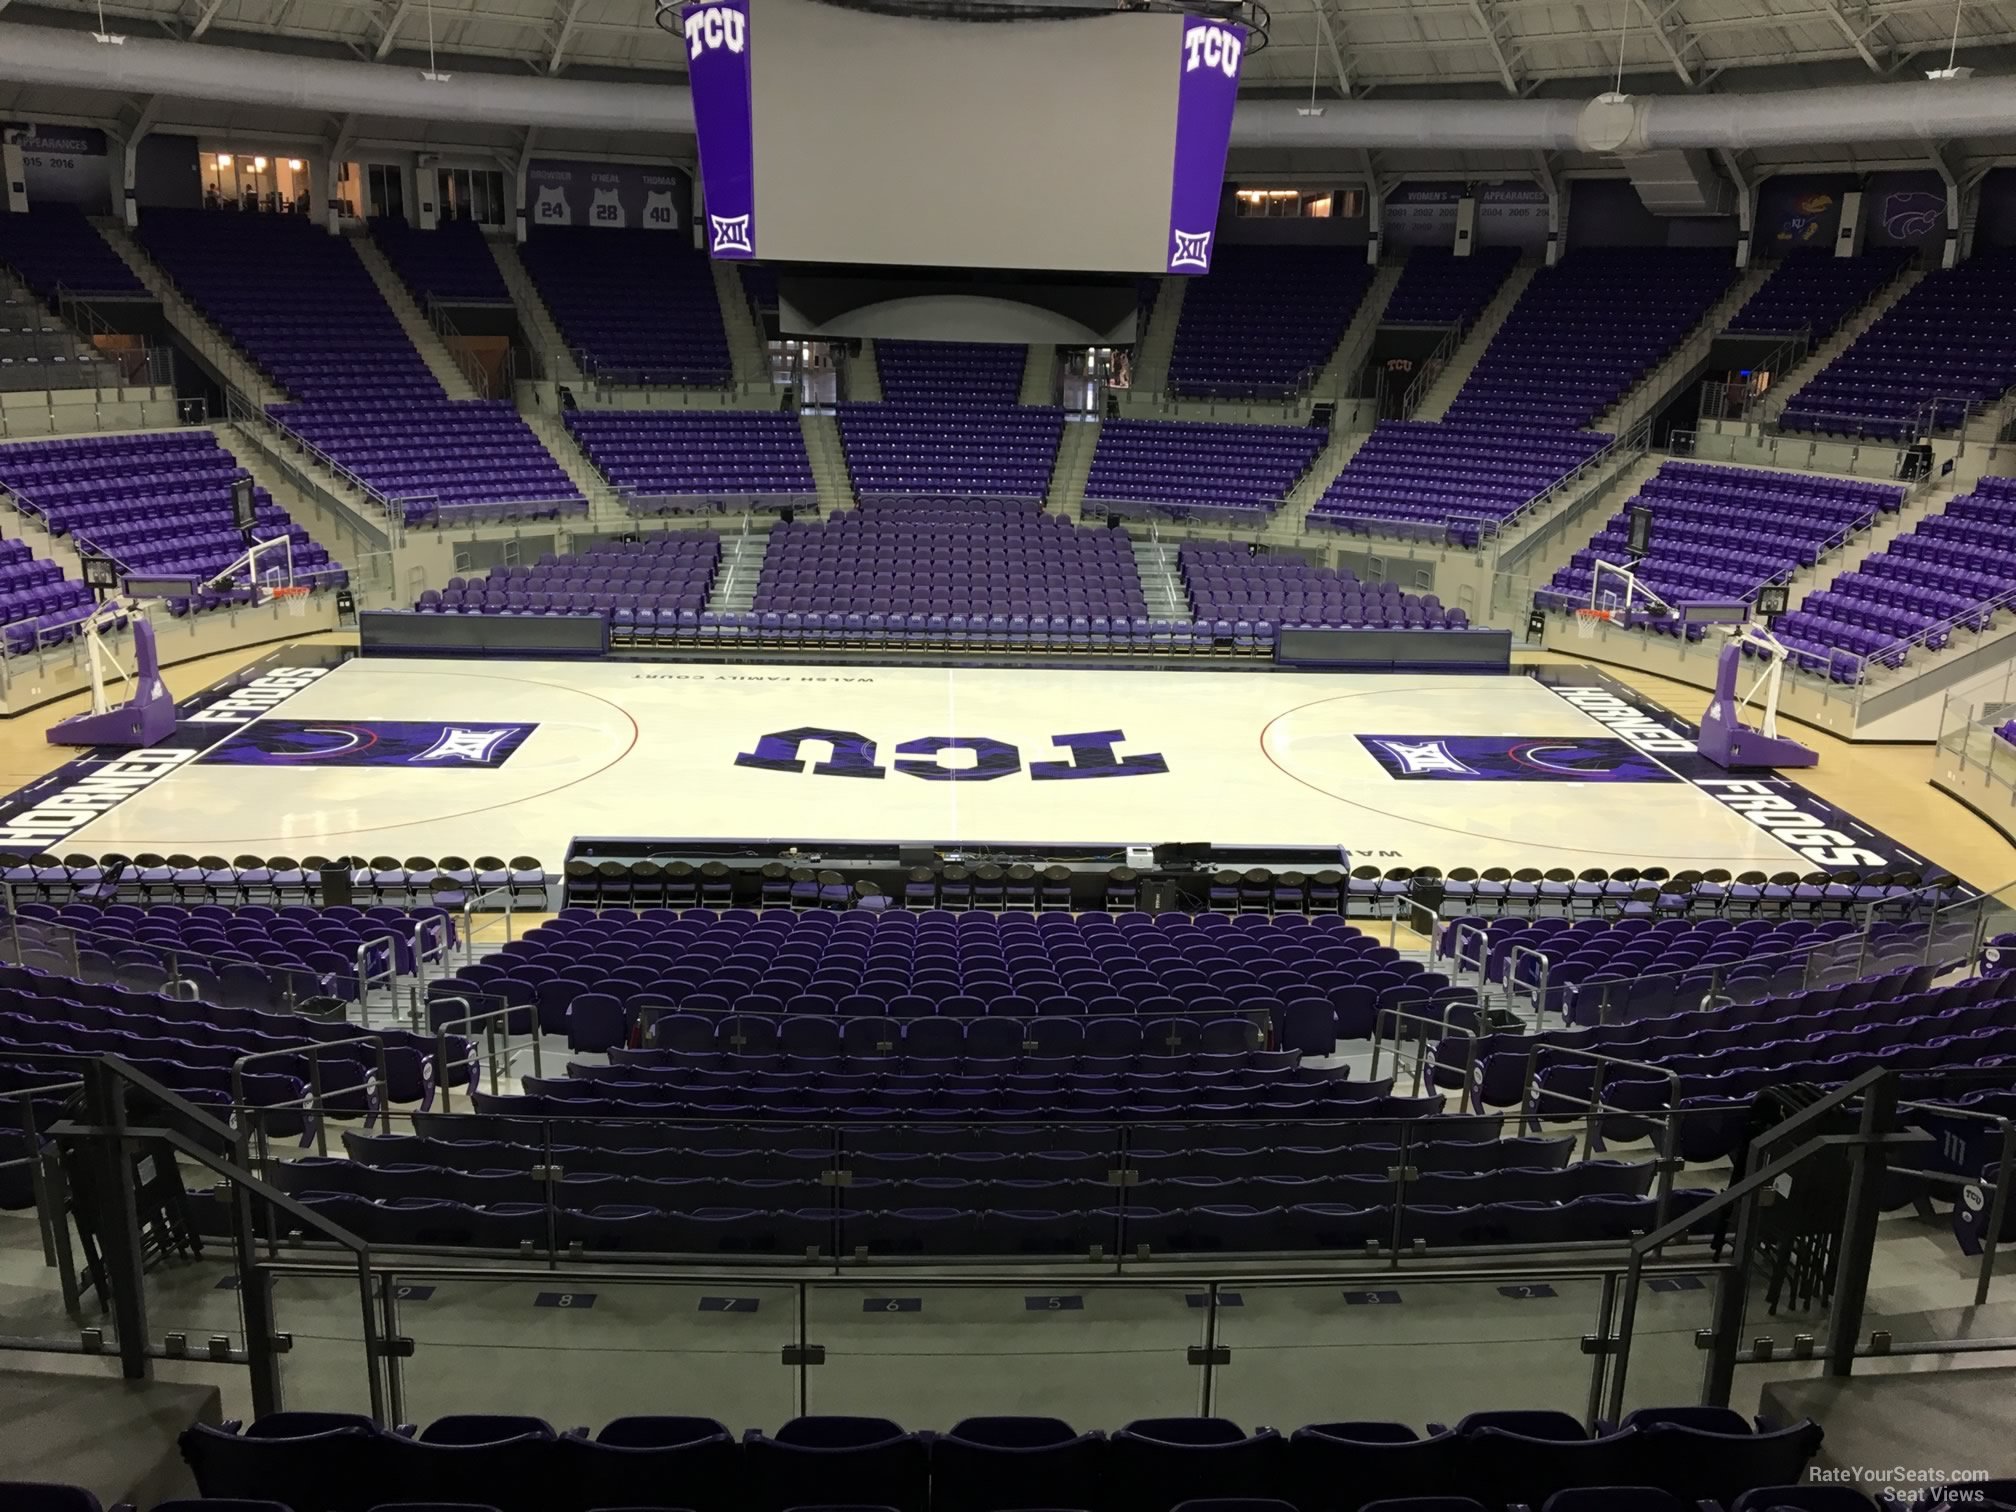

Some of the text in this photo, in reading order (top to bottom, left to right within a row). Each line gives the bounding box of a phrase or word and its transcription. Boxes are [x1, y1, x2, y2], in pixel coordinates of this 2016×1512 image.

[685, 7, 745, 60] TCU
[1185, 25, 1242, 78] TCU
[23, 157, 74, 169] 015 2016
[642, 175, 676, 186] THOMAS
[1408, 191, 1447, 201] WOMEN'S
[1483, 191, 1545, 201] APPEARANCES
[541, 202, 563, 218] 24
[596, 204, 618, 220] 28
[650, 207, 671, 222] 40
[1387, 359, 1412, 372] TCU
[185, 667, 329, 723] FROGS
[1550, 686, 1698, 752] HORNED
[734, 727, 1170, 781] TCU
[0, 749, 198, 846] HORNED
[1693, 780, 1888, 866] FROGS
[1944, 1129, 1966, 1166] 111
[1965, 1189, 1981, 1205] TCU
[1366, 1292, 1380, 1304] 3
[1519, 1287, 1535, 1298] 2
[558, 1294, 573, 1307] 8
[722, 1299, 737, 1311] 7
[886, 1299, 900, 1311] 6
[1048, 1297, 1062, 1309] 5
